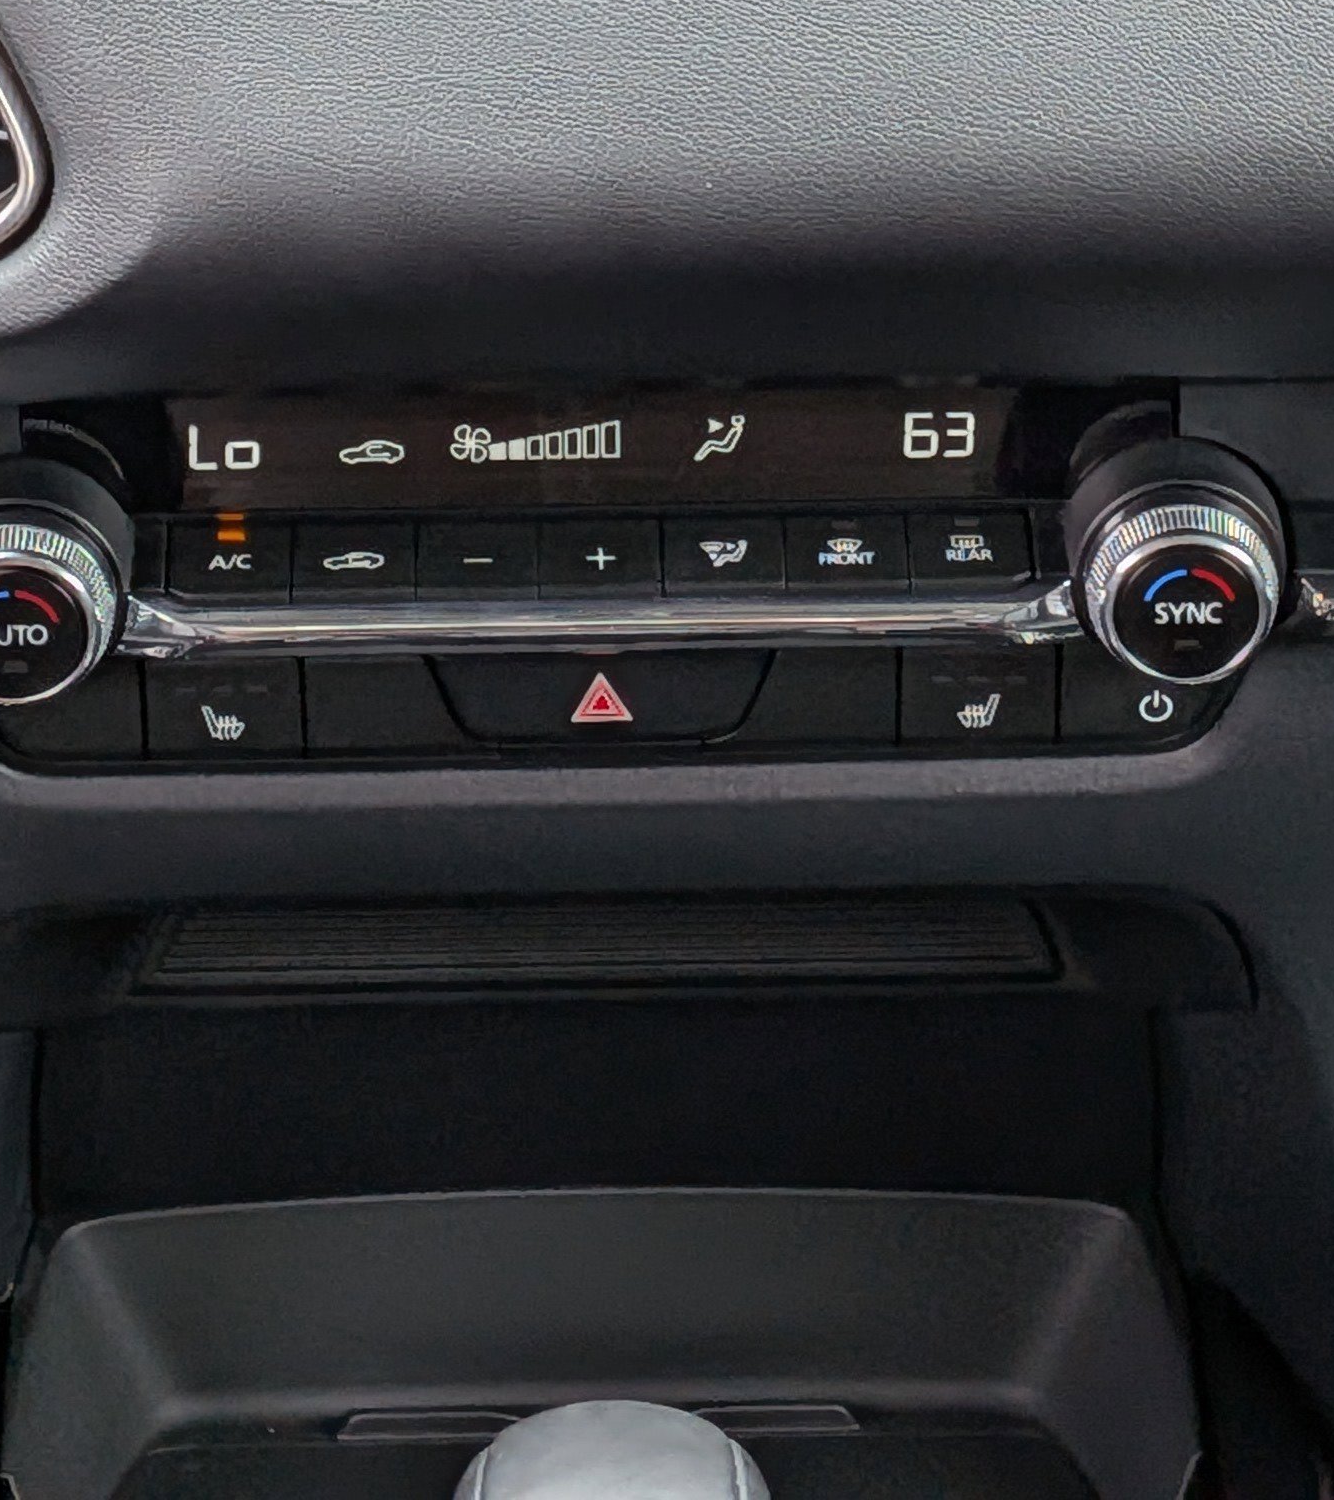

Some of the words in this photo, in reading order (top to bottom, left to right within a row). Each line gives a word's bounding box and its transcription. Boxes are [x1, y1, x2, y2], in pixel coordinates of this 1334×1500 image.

[902, 411, 976, 460] 63
[208, 554, 253, 571] A/C
[818, 551, 876, 566] FRONT
[945, 548, 994, 563] REAR
[1153, 601, 1224, 627] SYNC
